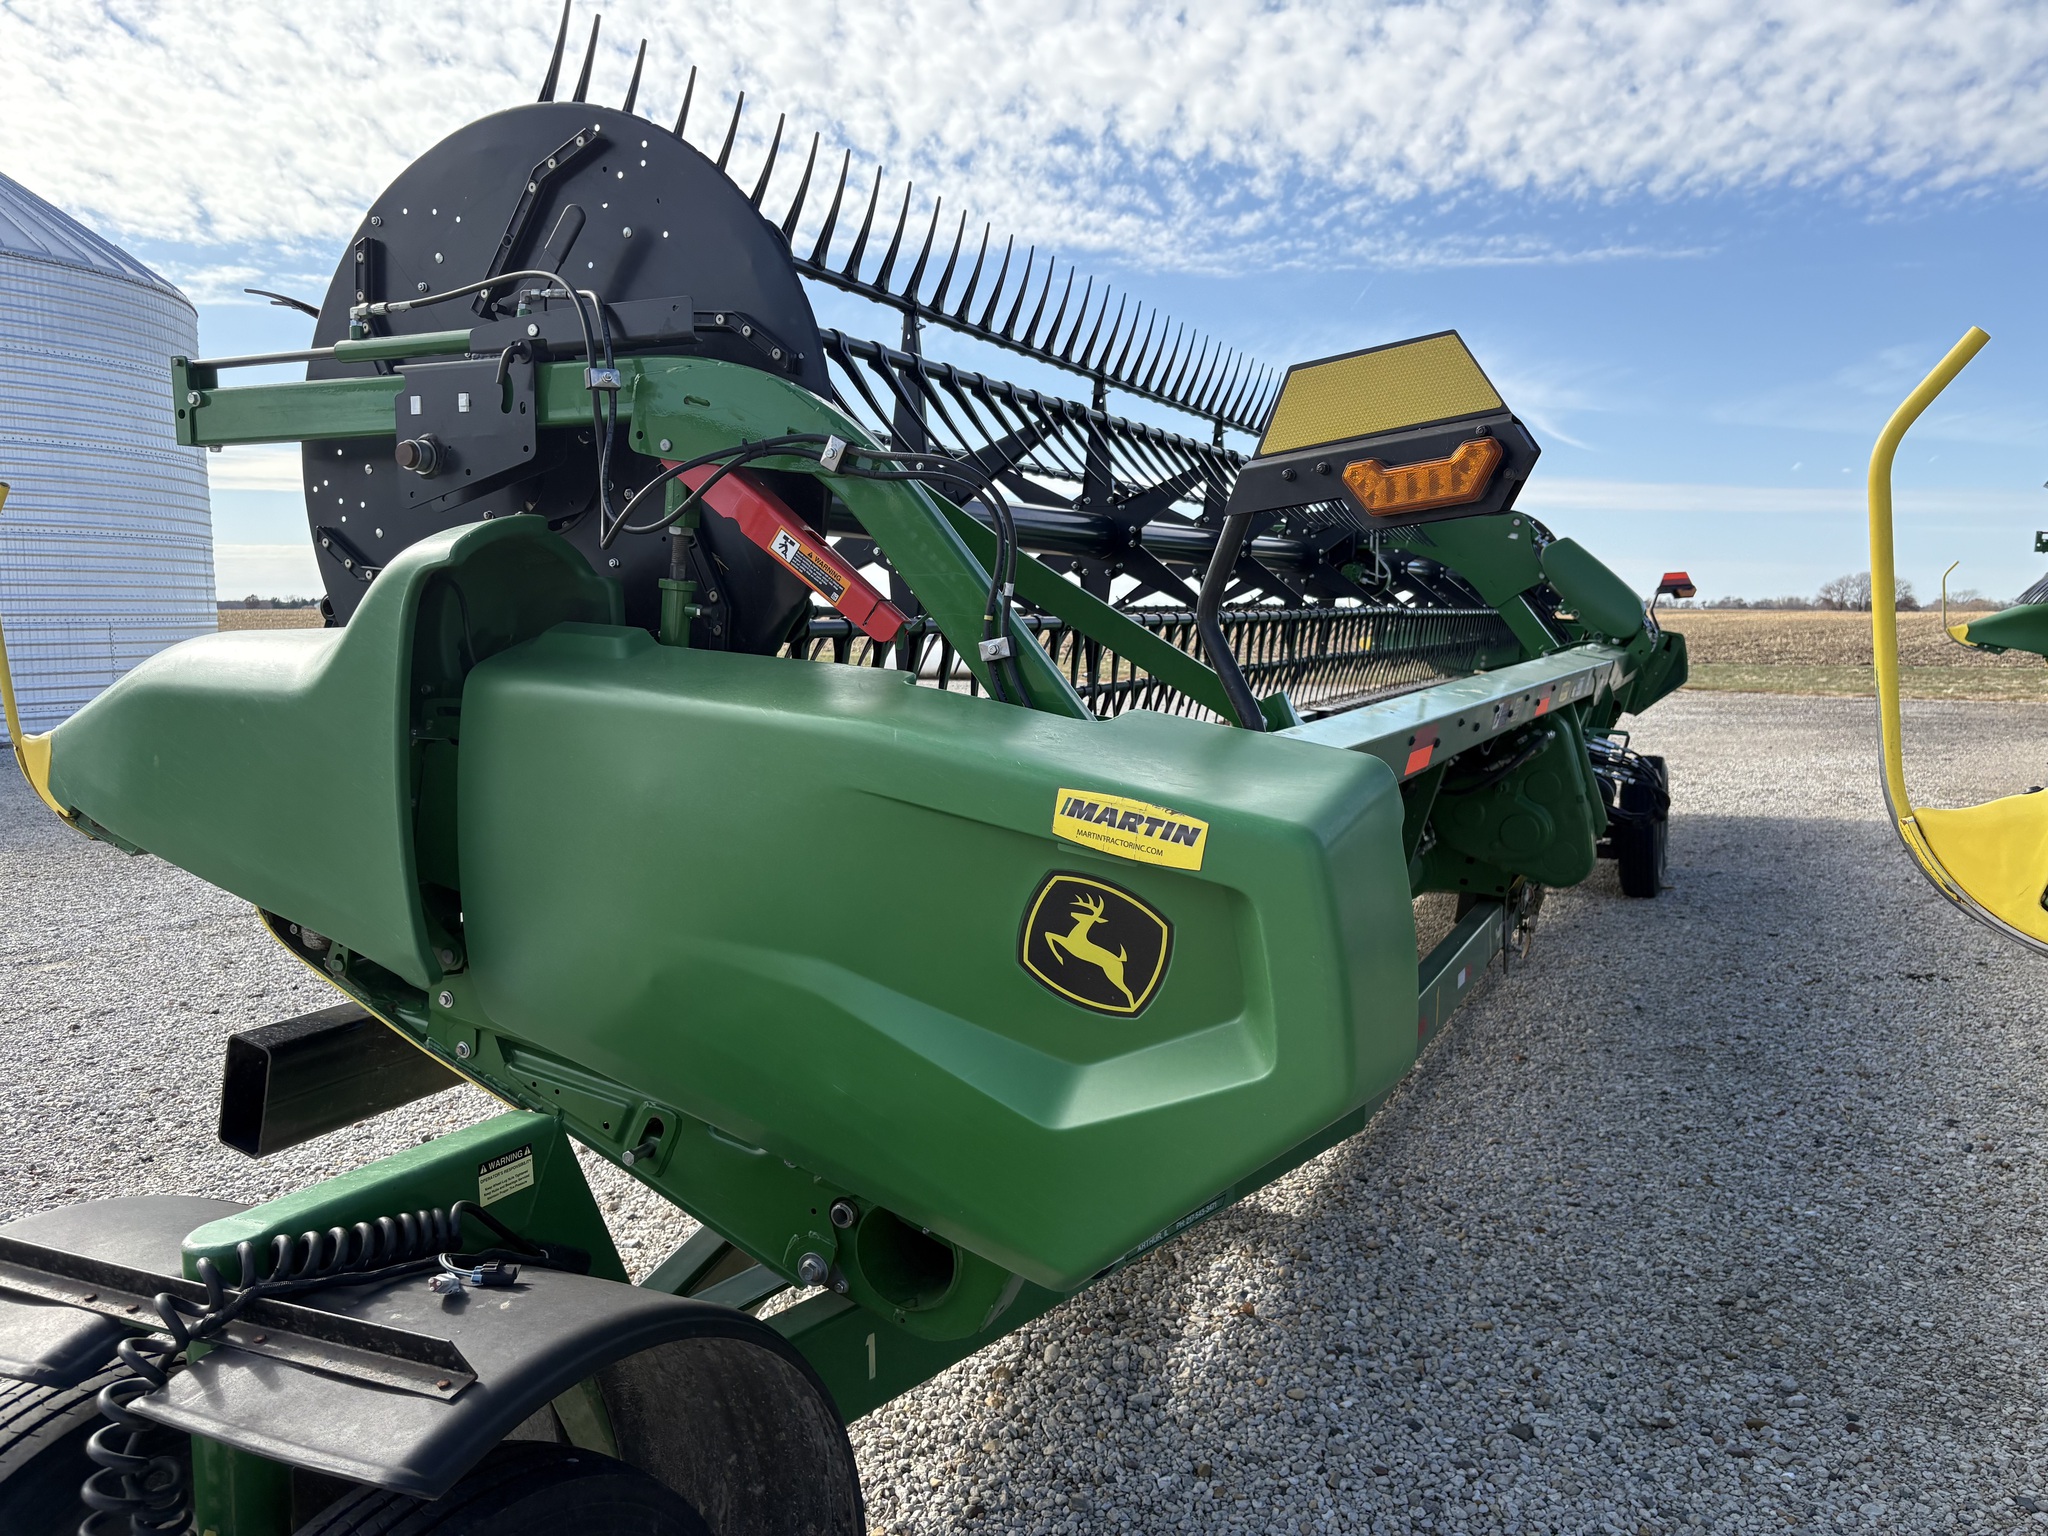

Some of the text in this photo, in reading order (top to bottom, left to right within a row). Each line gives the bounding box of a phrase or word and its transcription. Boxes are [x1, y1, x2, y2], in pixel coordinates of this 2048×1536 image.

[814, 556, 842, 582] WARNING
[1066, 798, 1202, 847] MARTIN
[1076, 828, 1164, 857] MARTINTRACTORINC.COM
[488, 1150, 523, 1171] WARNING
[480, 1170, 503, 1184] OPERATOR'S
[865, 1332, 876, 1380] 1
